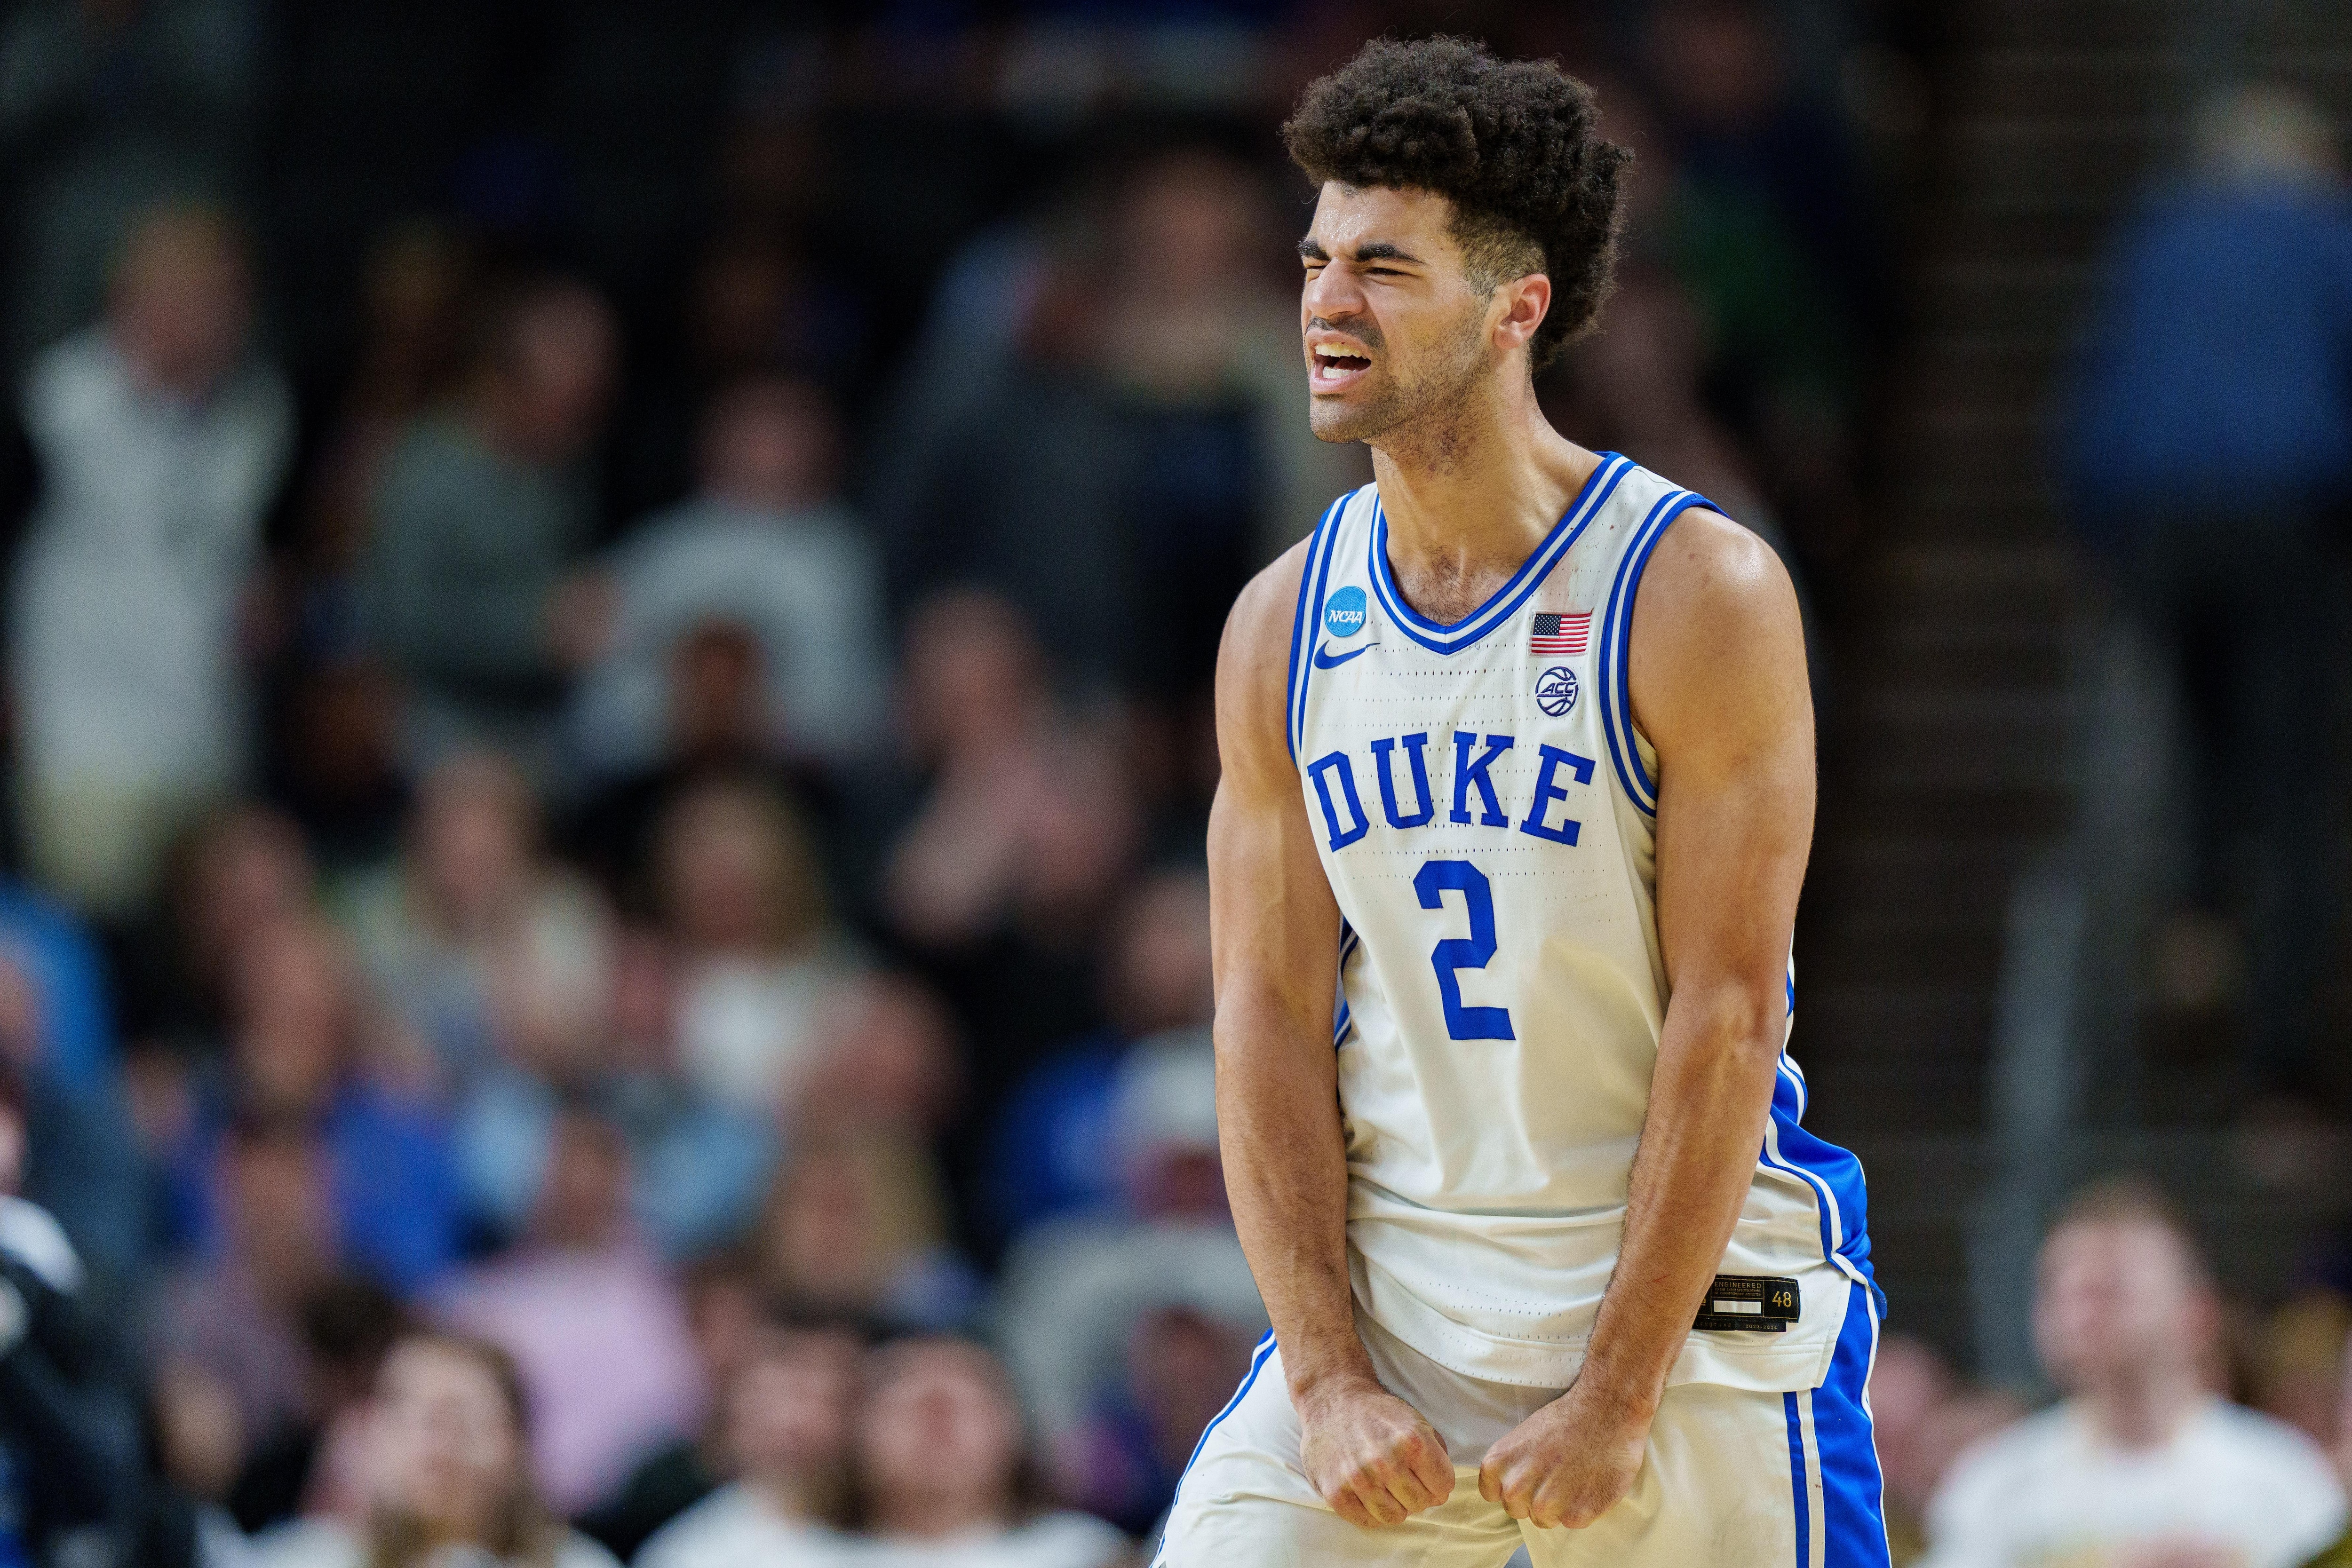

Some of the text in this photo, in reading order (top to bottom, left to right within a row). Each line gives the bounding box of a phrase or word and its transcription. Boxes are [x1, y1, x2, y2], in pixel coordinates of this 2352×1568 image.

[1328, 610, 1363, 624] NCAA
[1541, 682, 1576, 694] ACC
[1307, 731, 1596, 852] DUKE
[1413, 860, 1516, 1040] 2
[1772, 1291, 1792, 1307] 48
